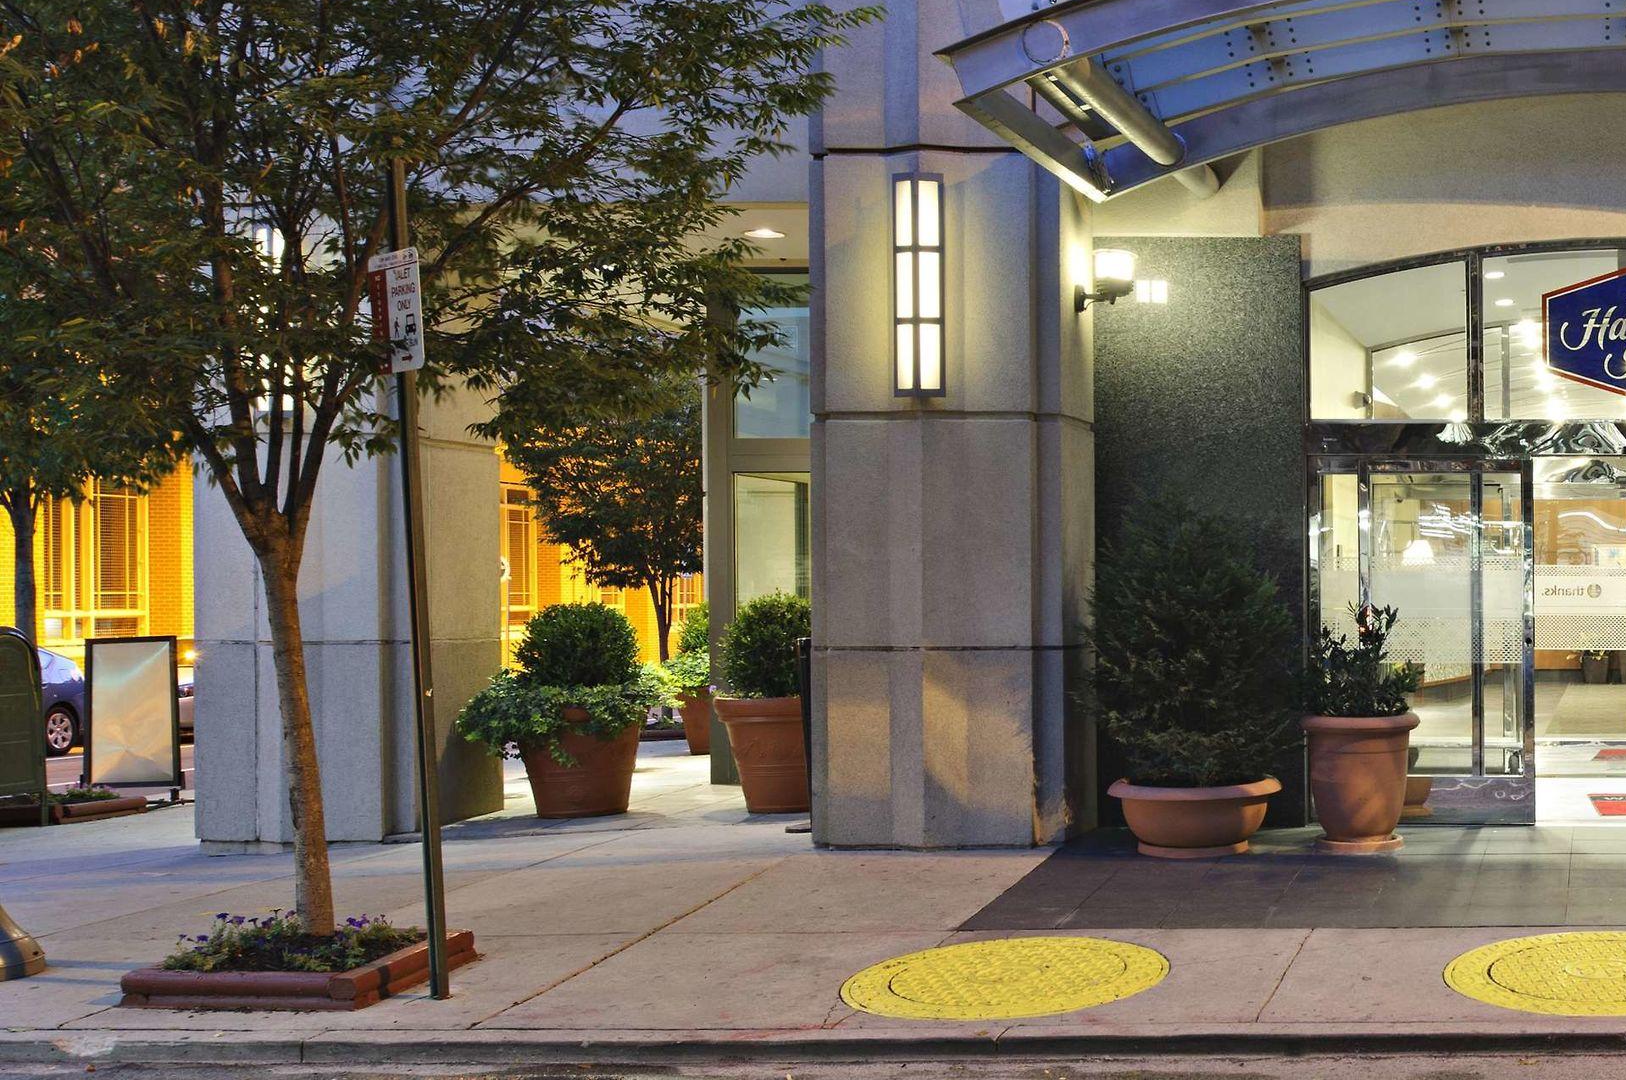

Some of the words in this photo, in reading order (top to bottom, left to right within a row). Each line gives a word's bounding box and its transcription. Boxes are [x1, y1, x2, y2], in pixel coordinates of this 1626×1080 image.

[393, 267, 411, 281] VALET
[391, 282, 416, 298] PARKING
[396, 298, 412, 312] ONLY
